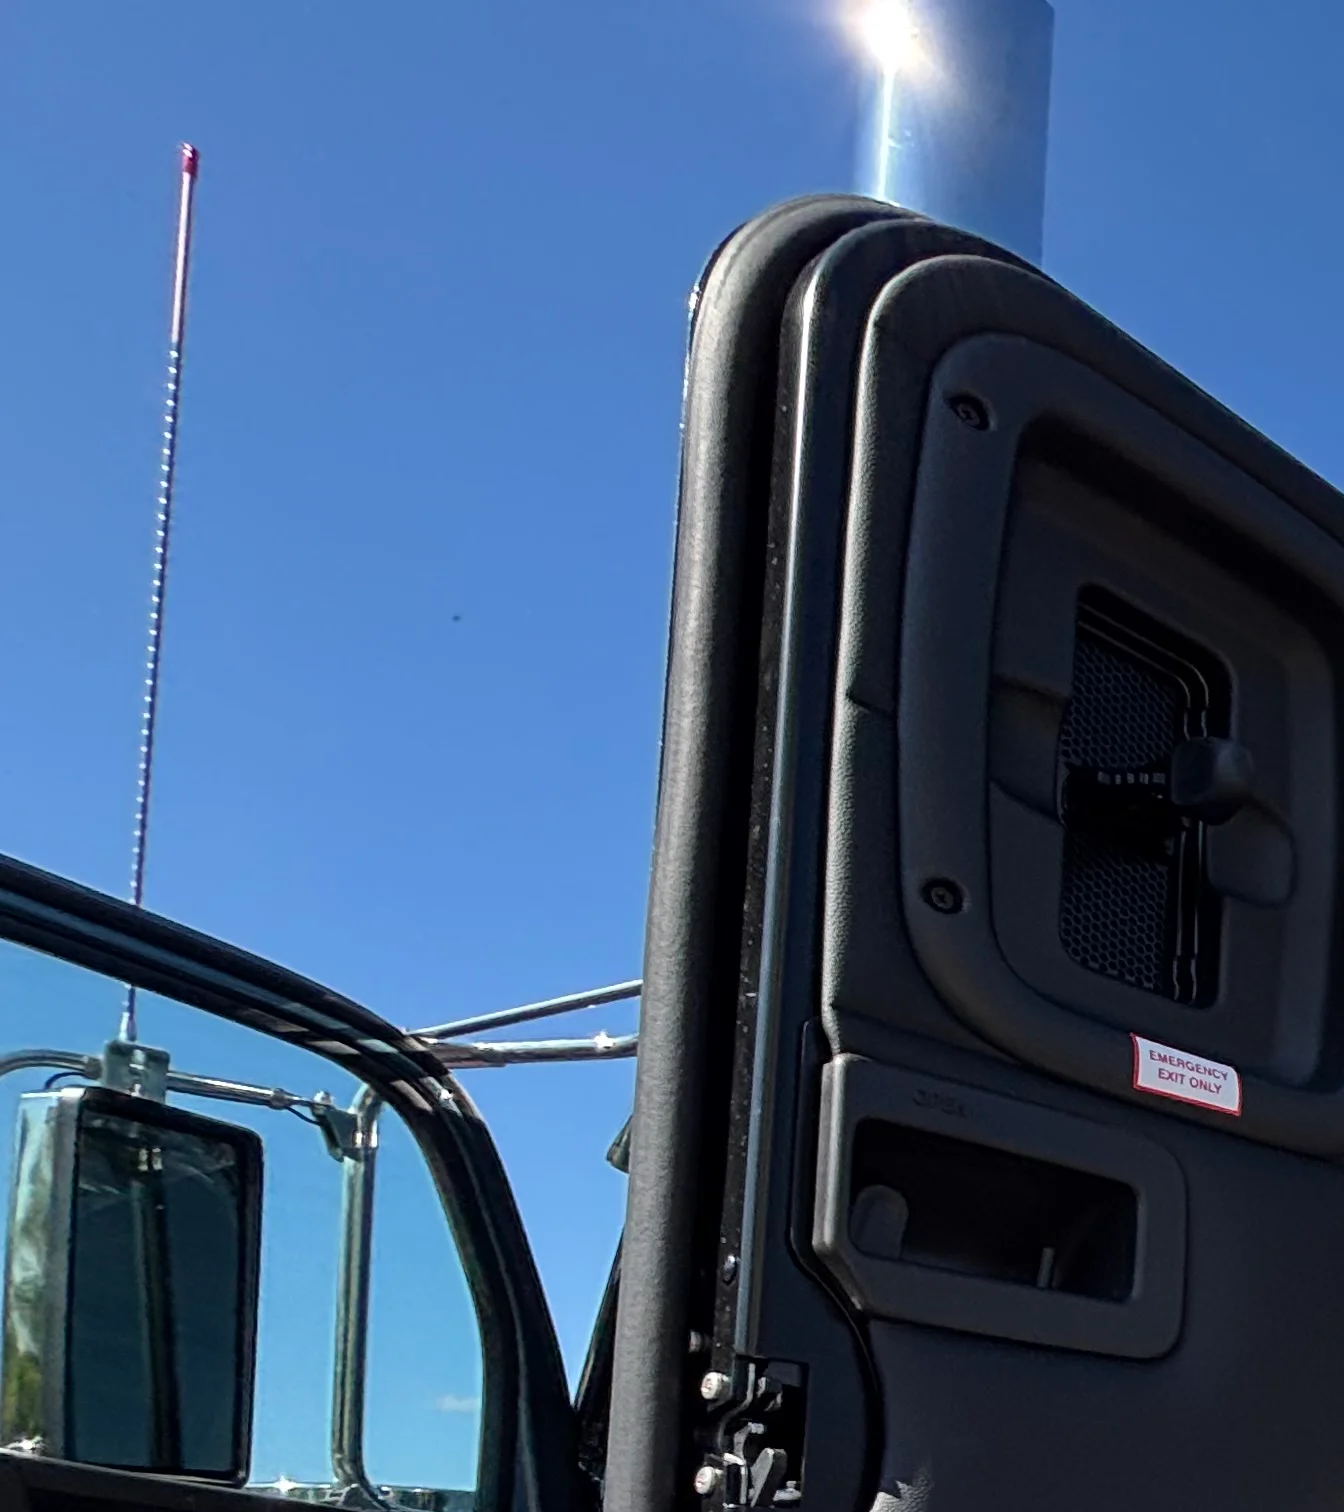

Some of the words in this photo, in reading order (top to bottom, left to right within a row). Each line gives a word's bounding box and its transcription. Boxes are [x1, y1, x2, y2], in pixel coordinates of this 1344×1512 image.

[1149, 1049, 1228, 1081] EMERGENCY
[1158, 1068, 1185, 1085] EXIT
[1189, 1076, 1222, 1095] ONLY
